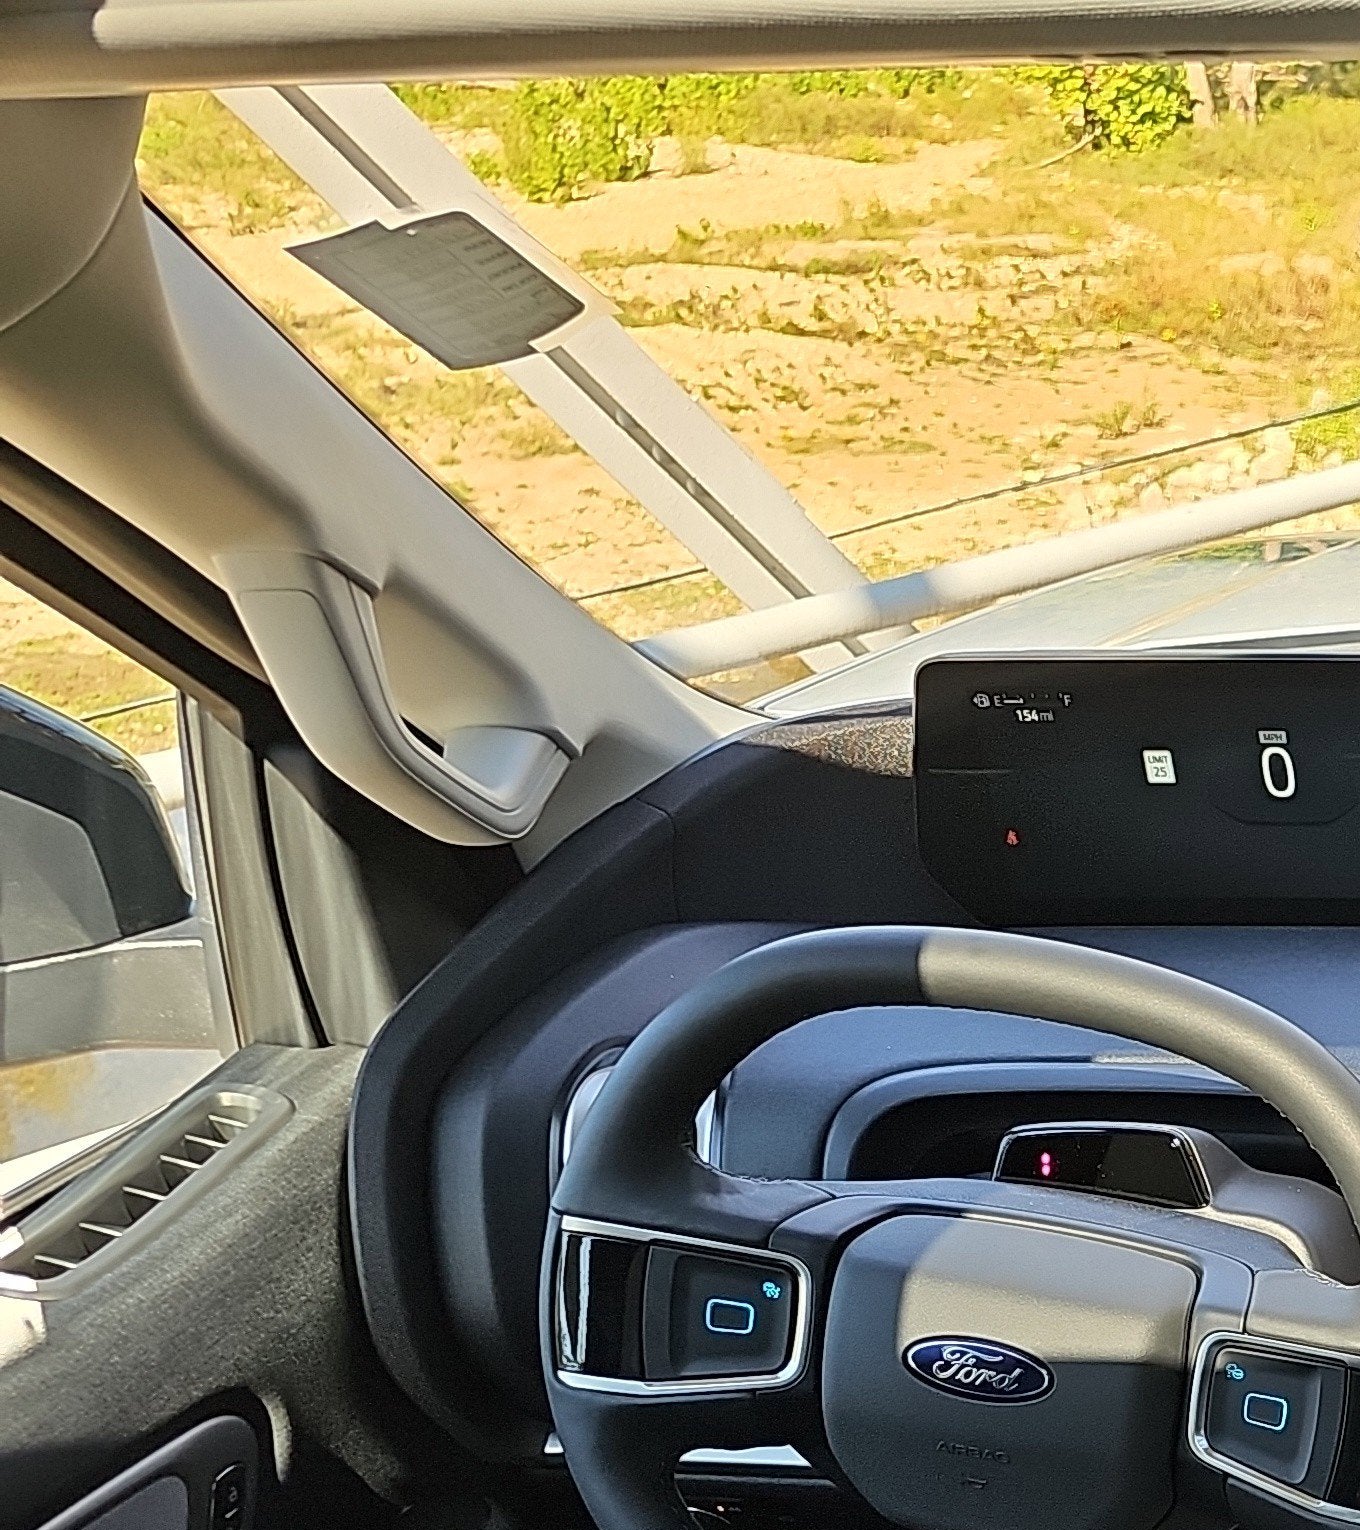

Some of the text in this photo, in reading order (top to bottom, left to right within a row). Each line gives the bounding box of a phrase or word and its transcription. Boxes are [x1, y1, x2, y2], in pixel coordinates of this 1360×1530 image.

[1262, 733, 1283, 742] MPH
[1147, 755, 1168, 765] LIMIT
[1154, 766, 1168, 778] 25
[1261, 746, 1296, 798] 0
[932, 1345, 1026, 1392] Ford
